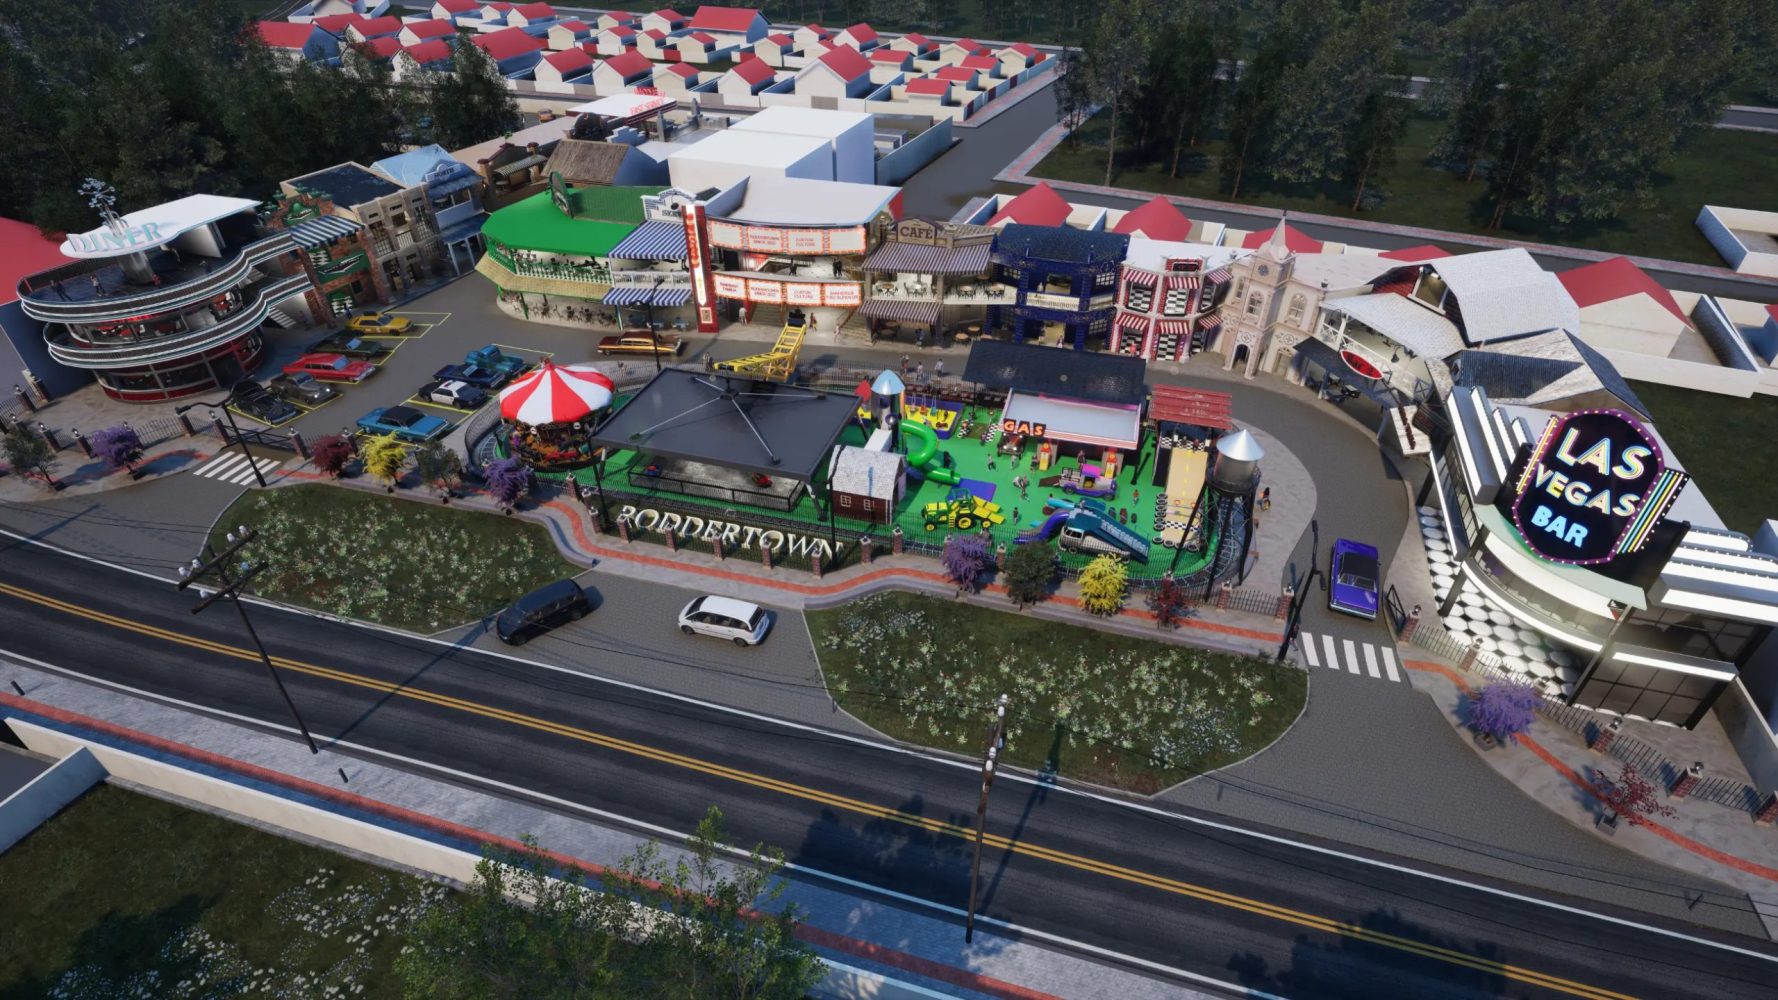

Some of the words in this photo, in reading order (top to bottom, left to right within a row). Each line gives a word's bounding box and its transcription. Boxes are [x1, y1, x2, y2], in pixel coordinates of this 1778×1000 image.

[66, 221, 163, 254] DINER
[900, 225, 933, 240] CAFÉ
[1004, 420, 1043, 436] GAS
[1556, 427, 1652, 480] LAS
[1536, 463, 1640, 517] VEGAS
[1531, 505, 1589, 548] BAR
